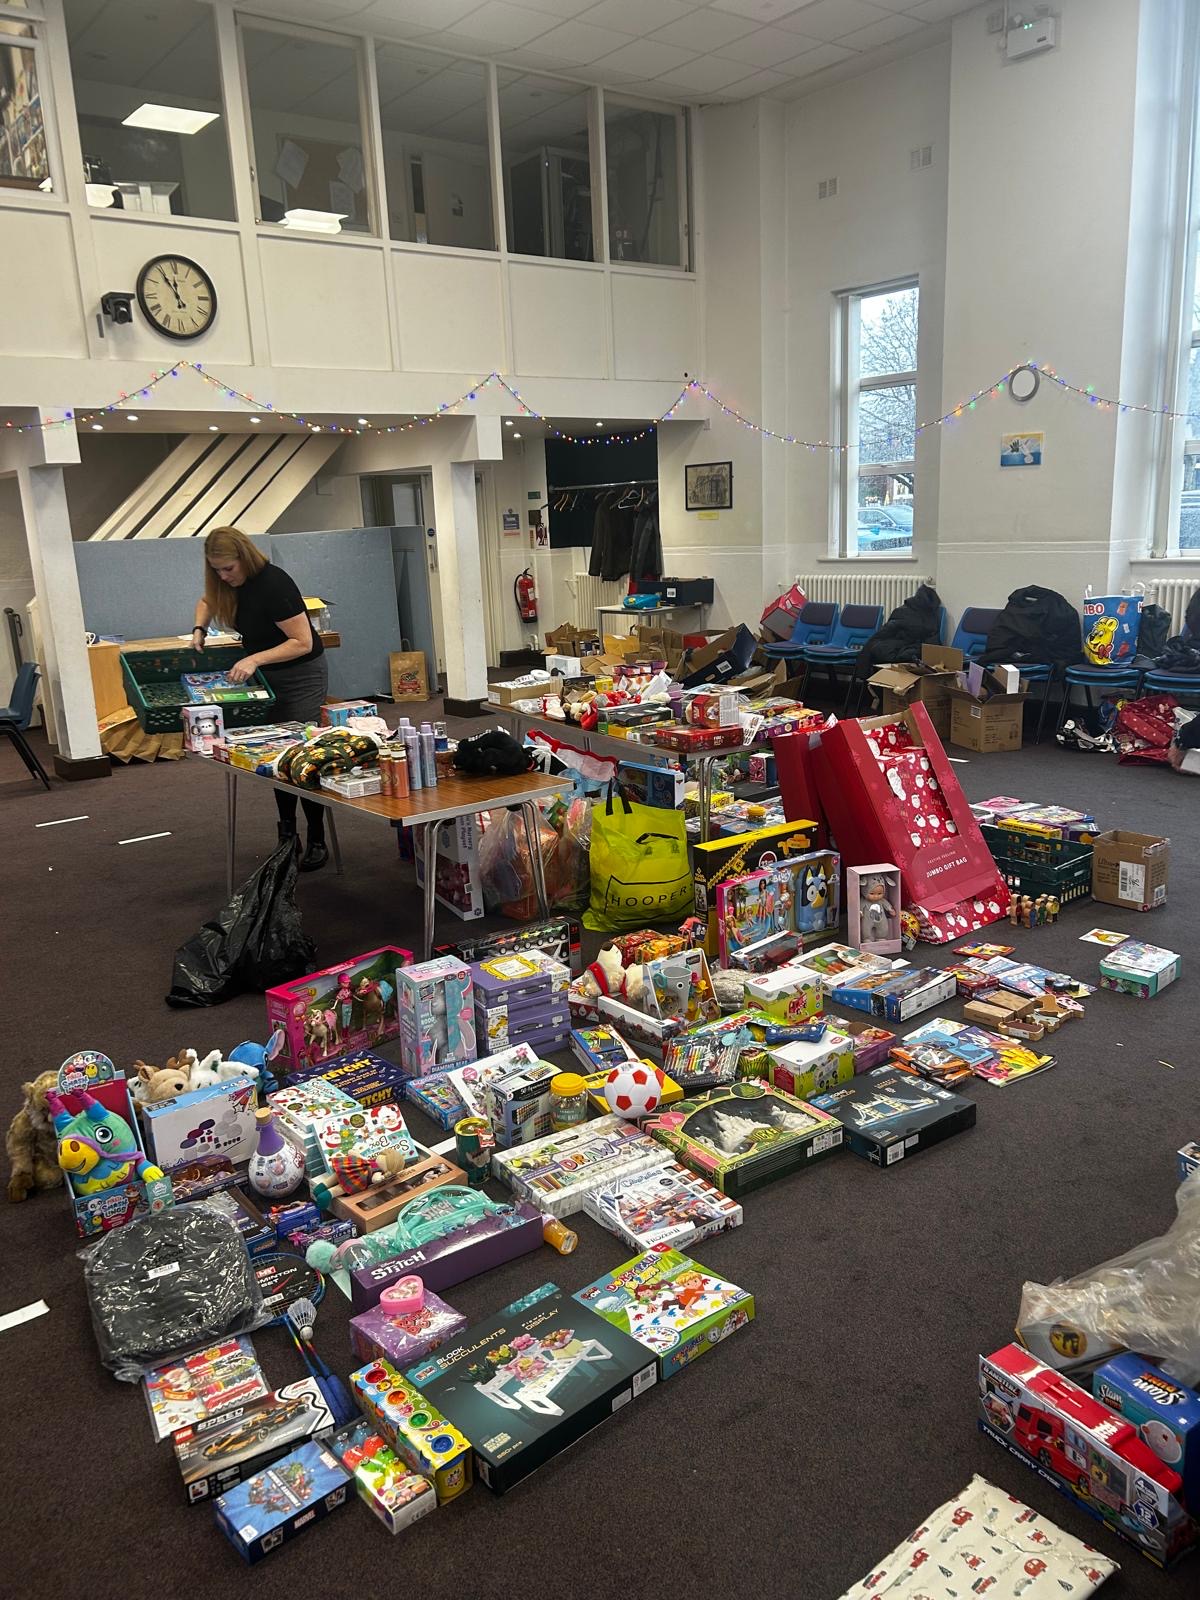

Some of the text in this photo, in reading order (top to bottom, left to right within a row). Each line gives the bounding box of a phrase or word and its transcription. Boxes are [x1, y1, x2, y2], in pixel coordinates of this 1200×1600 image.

[926, 856, 968, 878] JUMBO GIFT BAG
[611, 884, 690, 907] HOOPER
[320, 1058, 372, 1080] KETCHY
[358, 1086, 393, 1107] ETCHY
[369, 1135, 390, 1149] Box
[559, 1142, 615, 1172] DRAW
[257, 1267, 298, 1284] MINTON
[525, 1308, 559, 1331] DISPLAY
[436, 1345, 465, 1365] BLOCK
[440, 1328, 507, 1369] SUCCULENTS
[197, 1407, 244, 1431] SPEED
[982, 1425, 1008, 1448] TRUCK
[1009, 1447, 1037, 1469] CARRY
